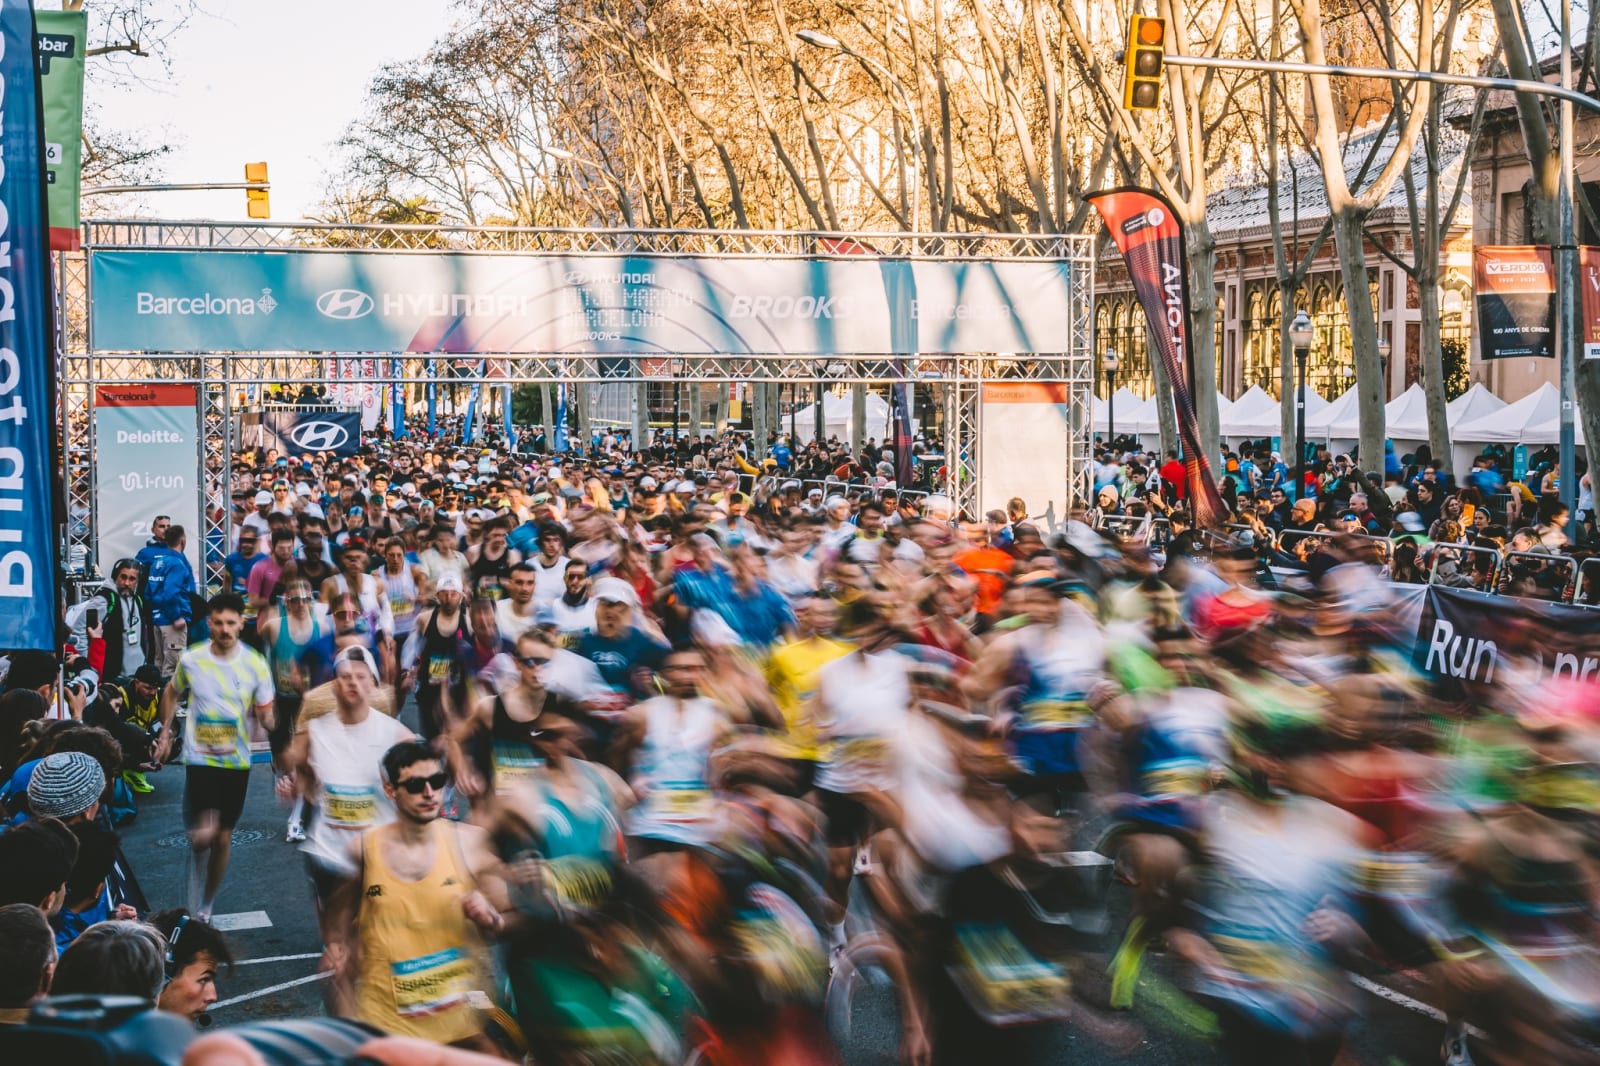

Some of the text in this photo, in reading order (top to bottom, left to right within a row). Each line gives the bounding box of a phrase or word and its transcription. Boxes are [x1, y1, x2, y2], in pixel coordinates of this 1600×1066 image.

[137, 292, 255, 315] Barcelona
[383, 294, 528, 317] HYUNDAI
[729, 295, 855, 319] BROOKS
[103, 391, 149, 401] Barcelona
[987, 390, 1025, 399] Barcelona
[116, 430, 184, 444] Deloitte.
[145, 472, 184, 489] i-run
[1425, 618, 1498, 684] Run
